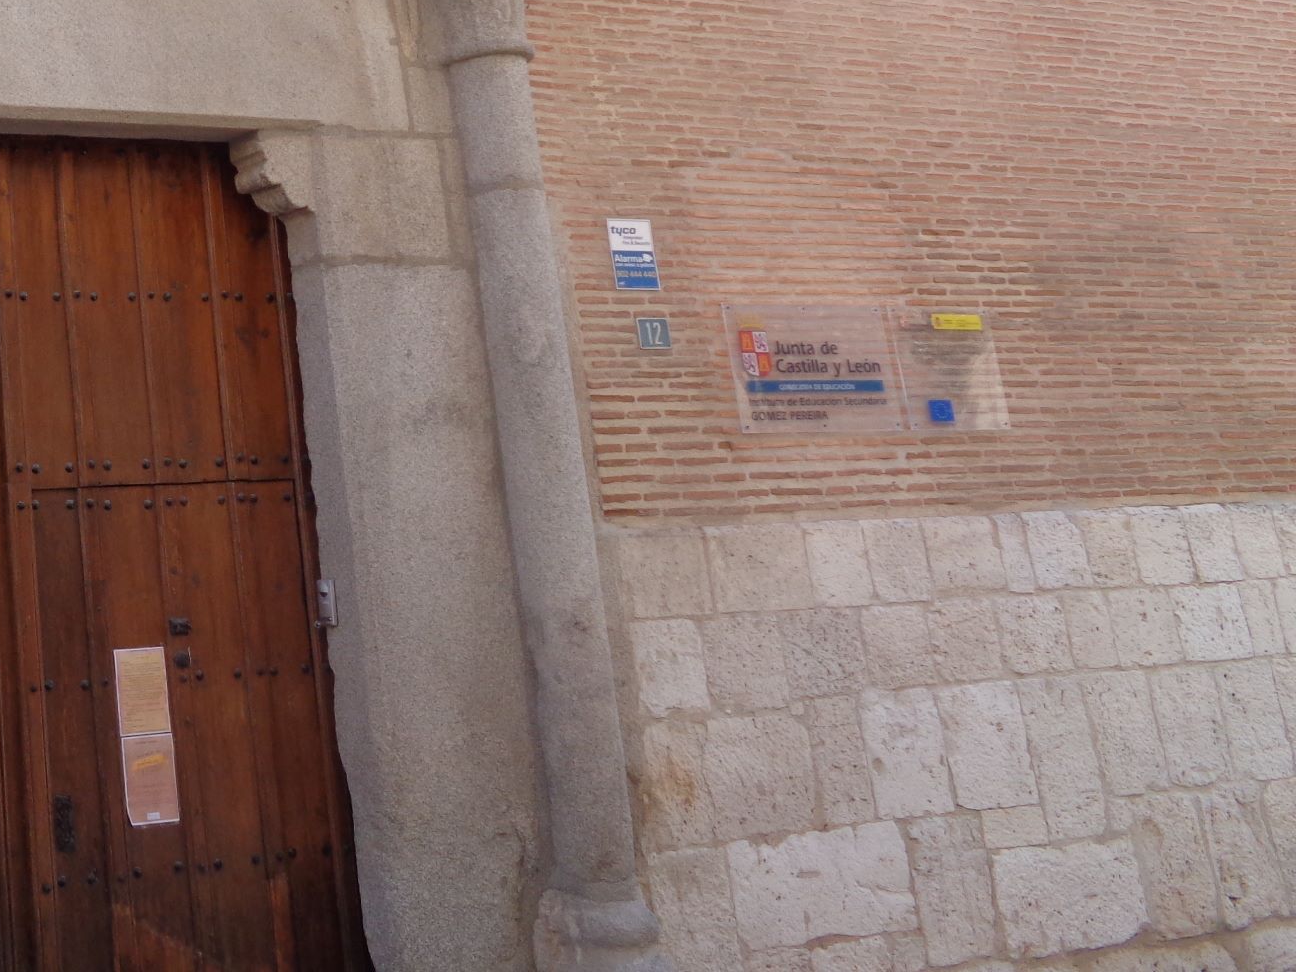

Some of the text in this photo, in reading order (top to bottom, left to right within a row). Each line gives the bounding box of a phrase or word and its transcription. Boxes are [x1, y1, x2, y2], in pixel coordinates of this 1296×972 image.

[610, 226, 636, 236] tyco
[645, 322, 664, 345] 12
[774, 340, 838, 355] Junta de
[776, 358, 882, 377] Castilla y León
